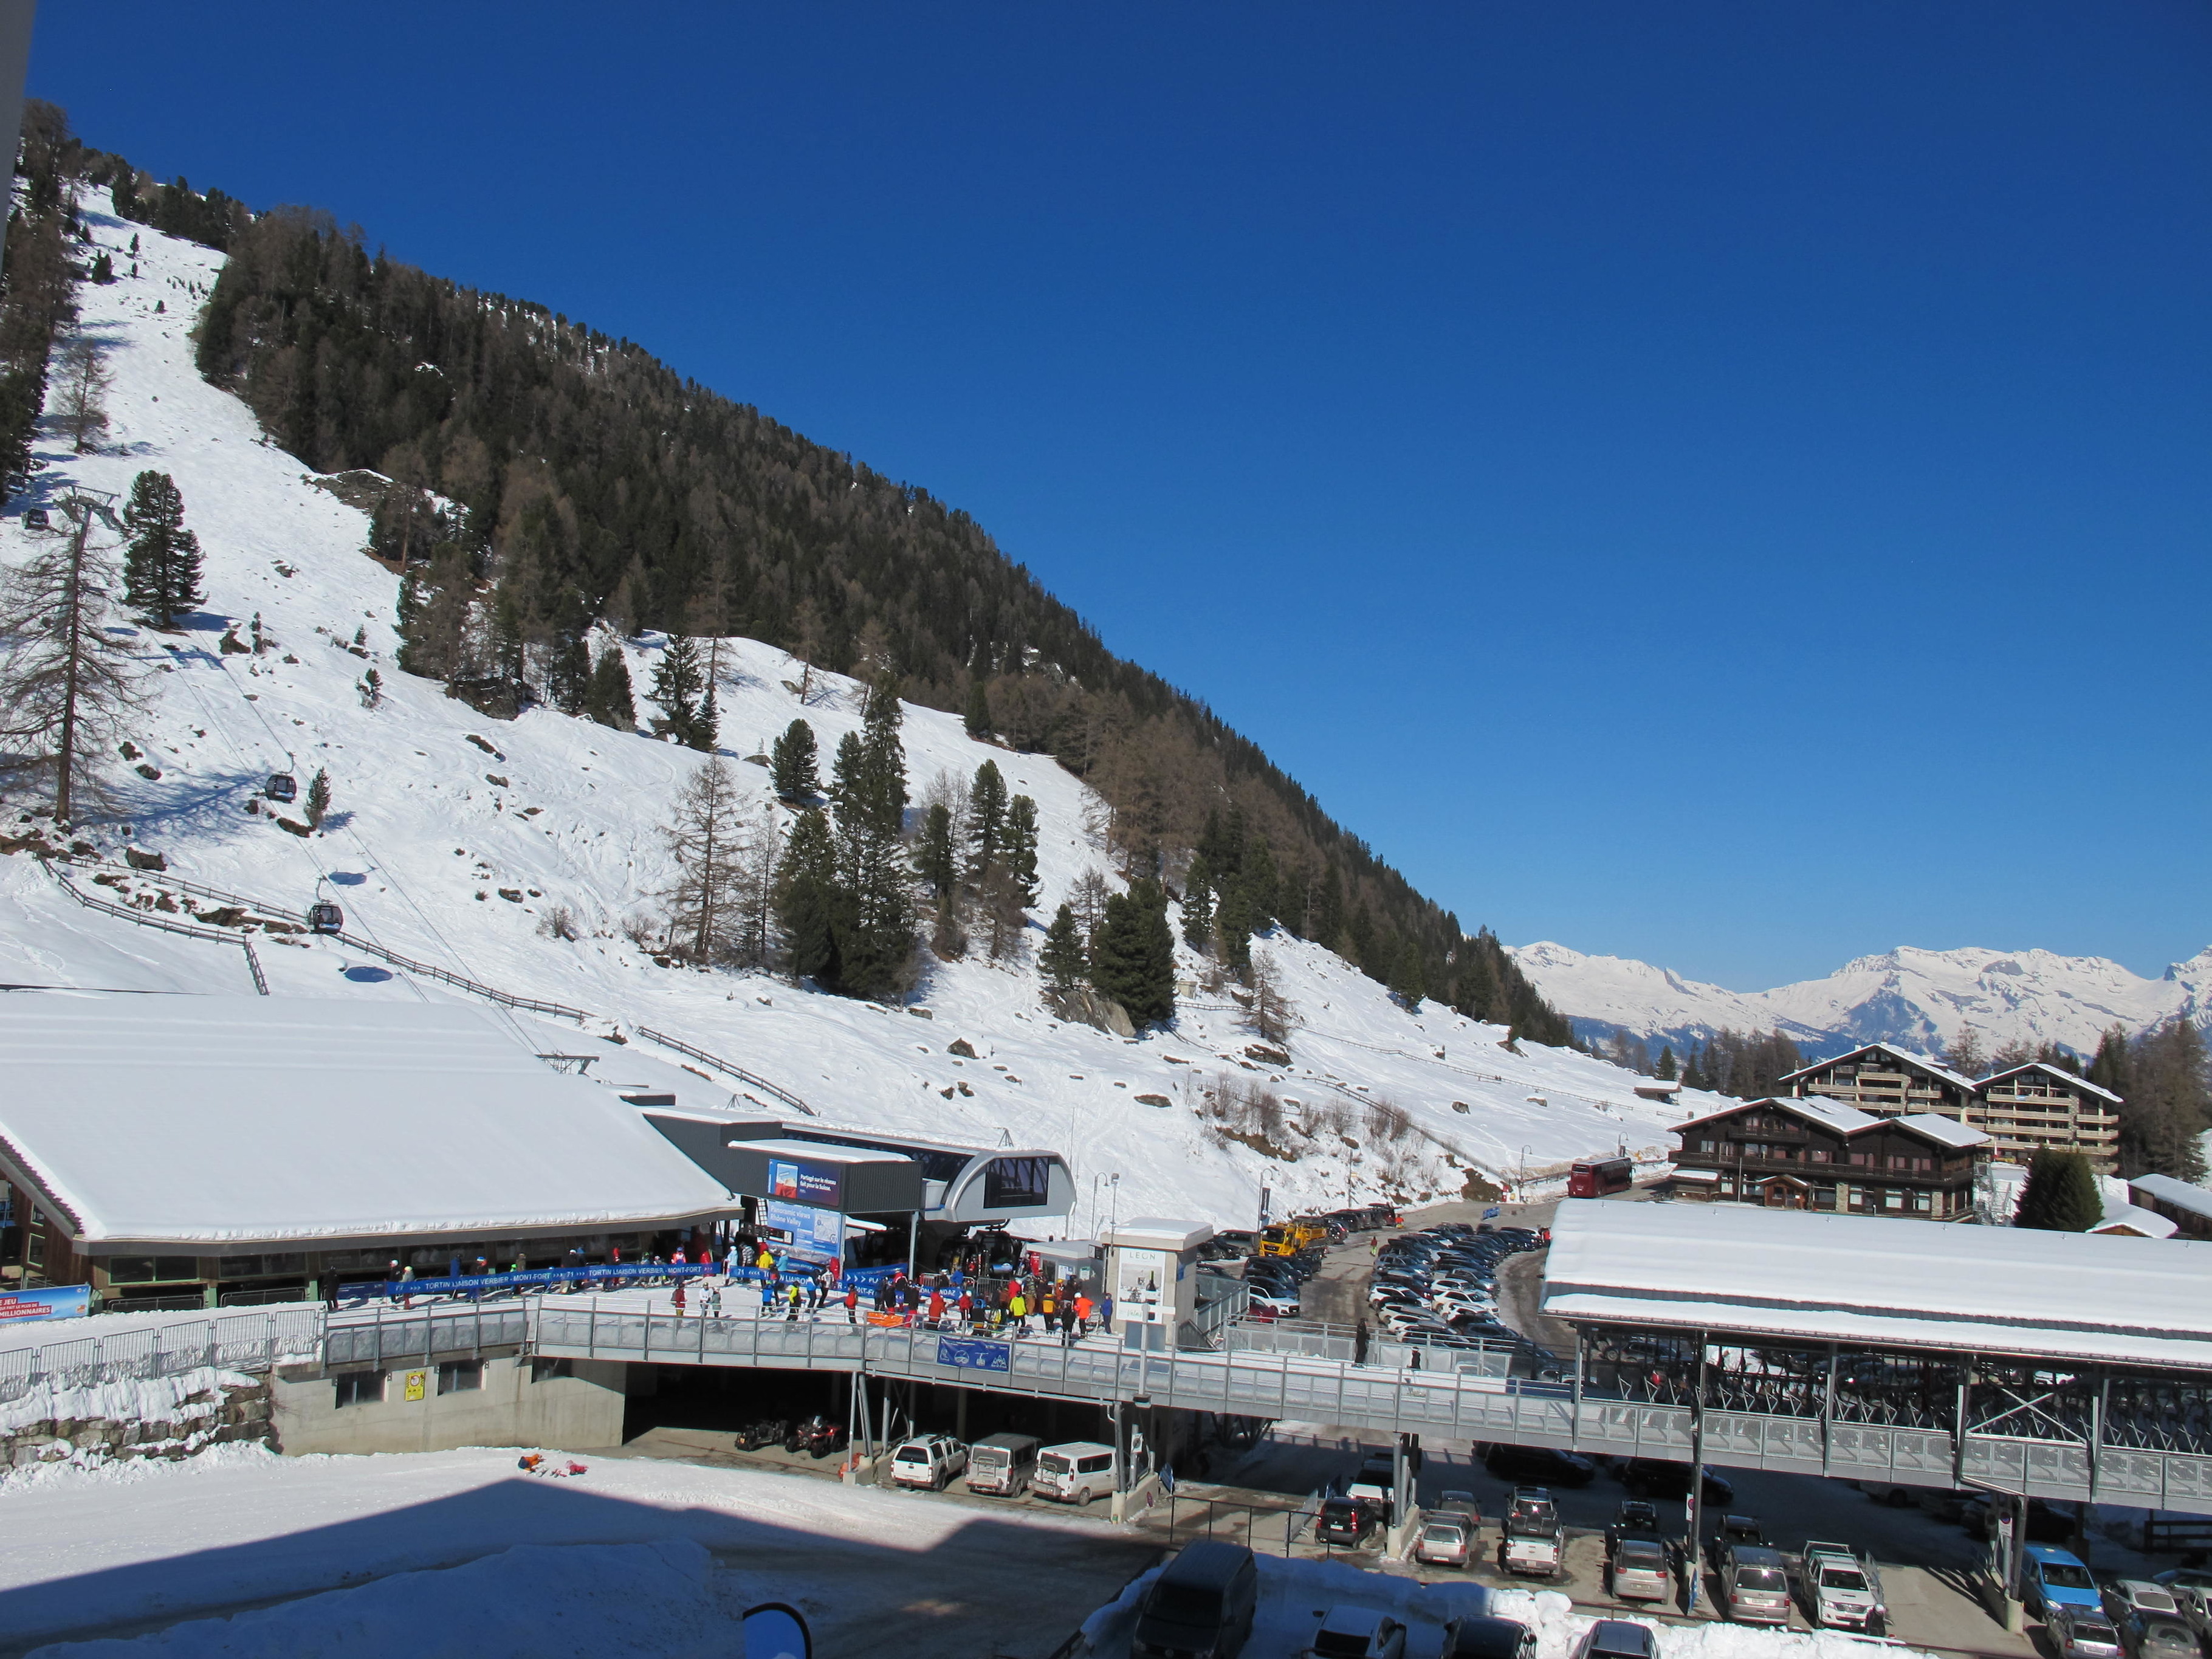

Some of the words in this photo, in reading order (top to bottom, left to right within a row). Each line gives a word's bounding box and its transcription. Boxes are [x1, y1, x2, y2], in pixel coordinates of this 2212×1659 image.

[425, 1281, 450, 1290] TORTIN
[452, 1279, 479, 1288] LIAISON
[514, 1273, 551, 1282] MONT-FORT
[0, 1306, 50, 1317] MILLIONNAIRES
